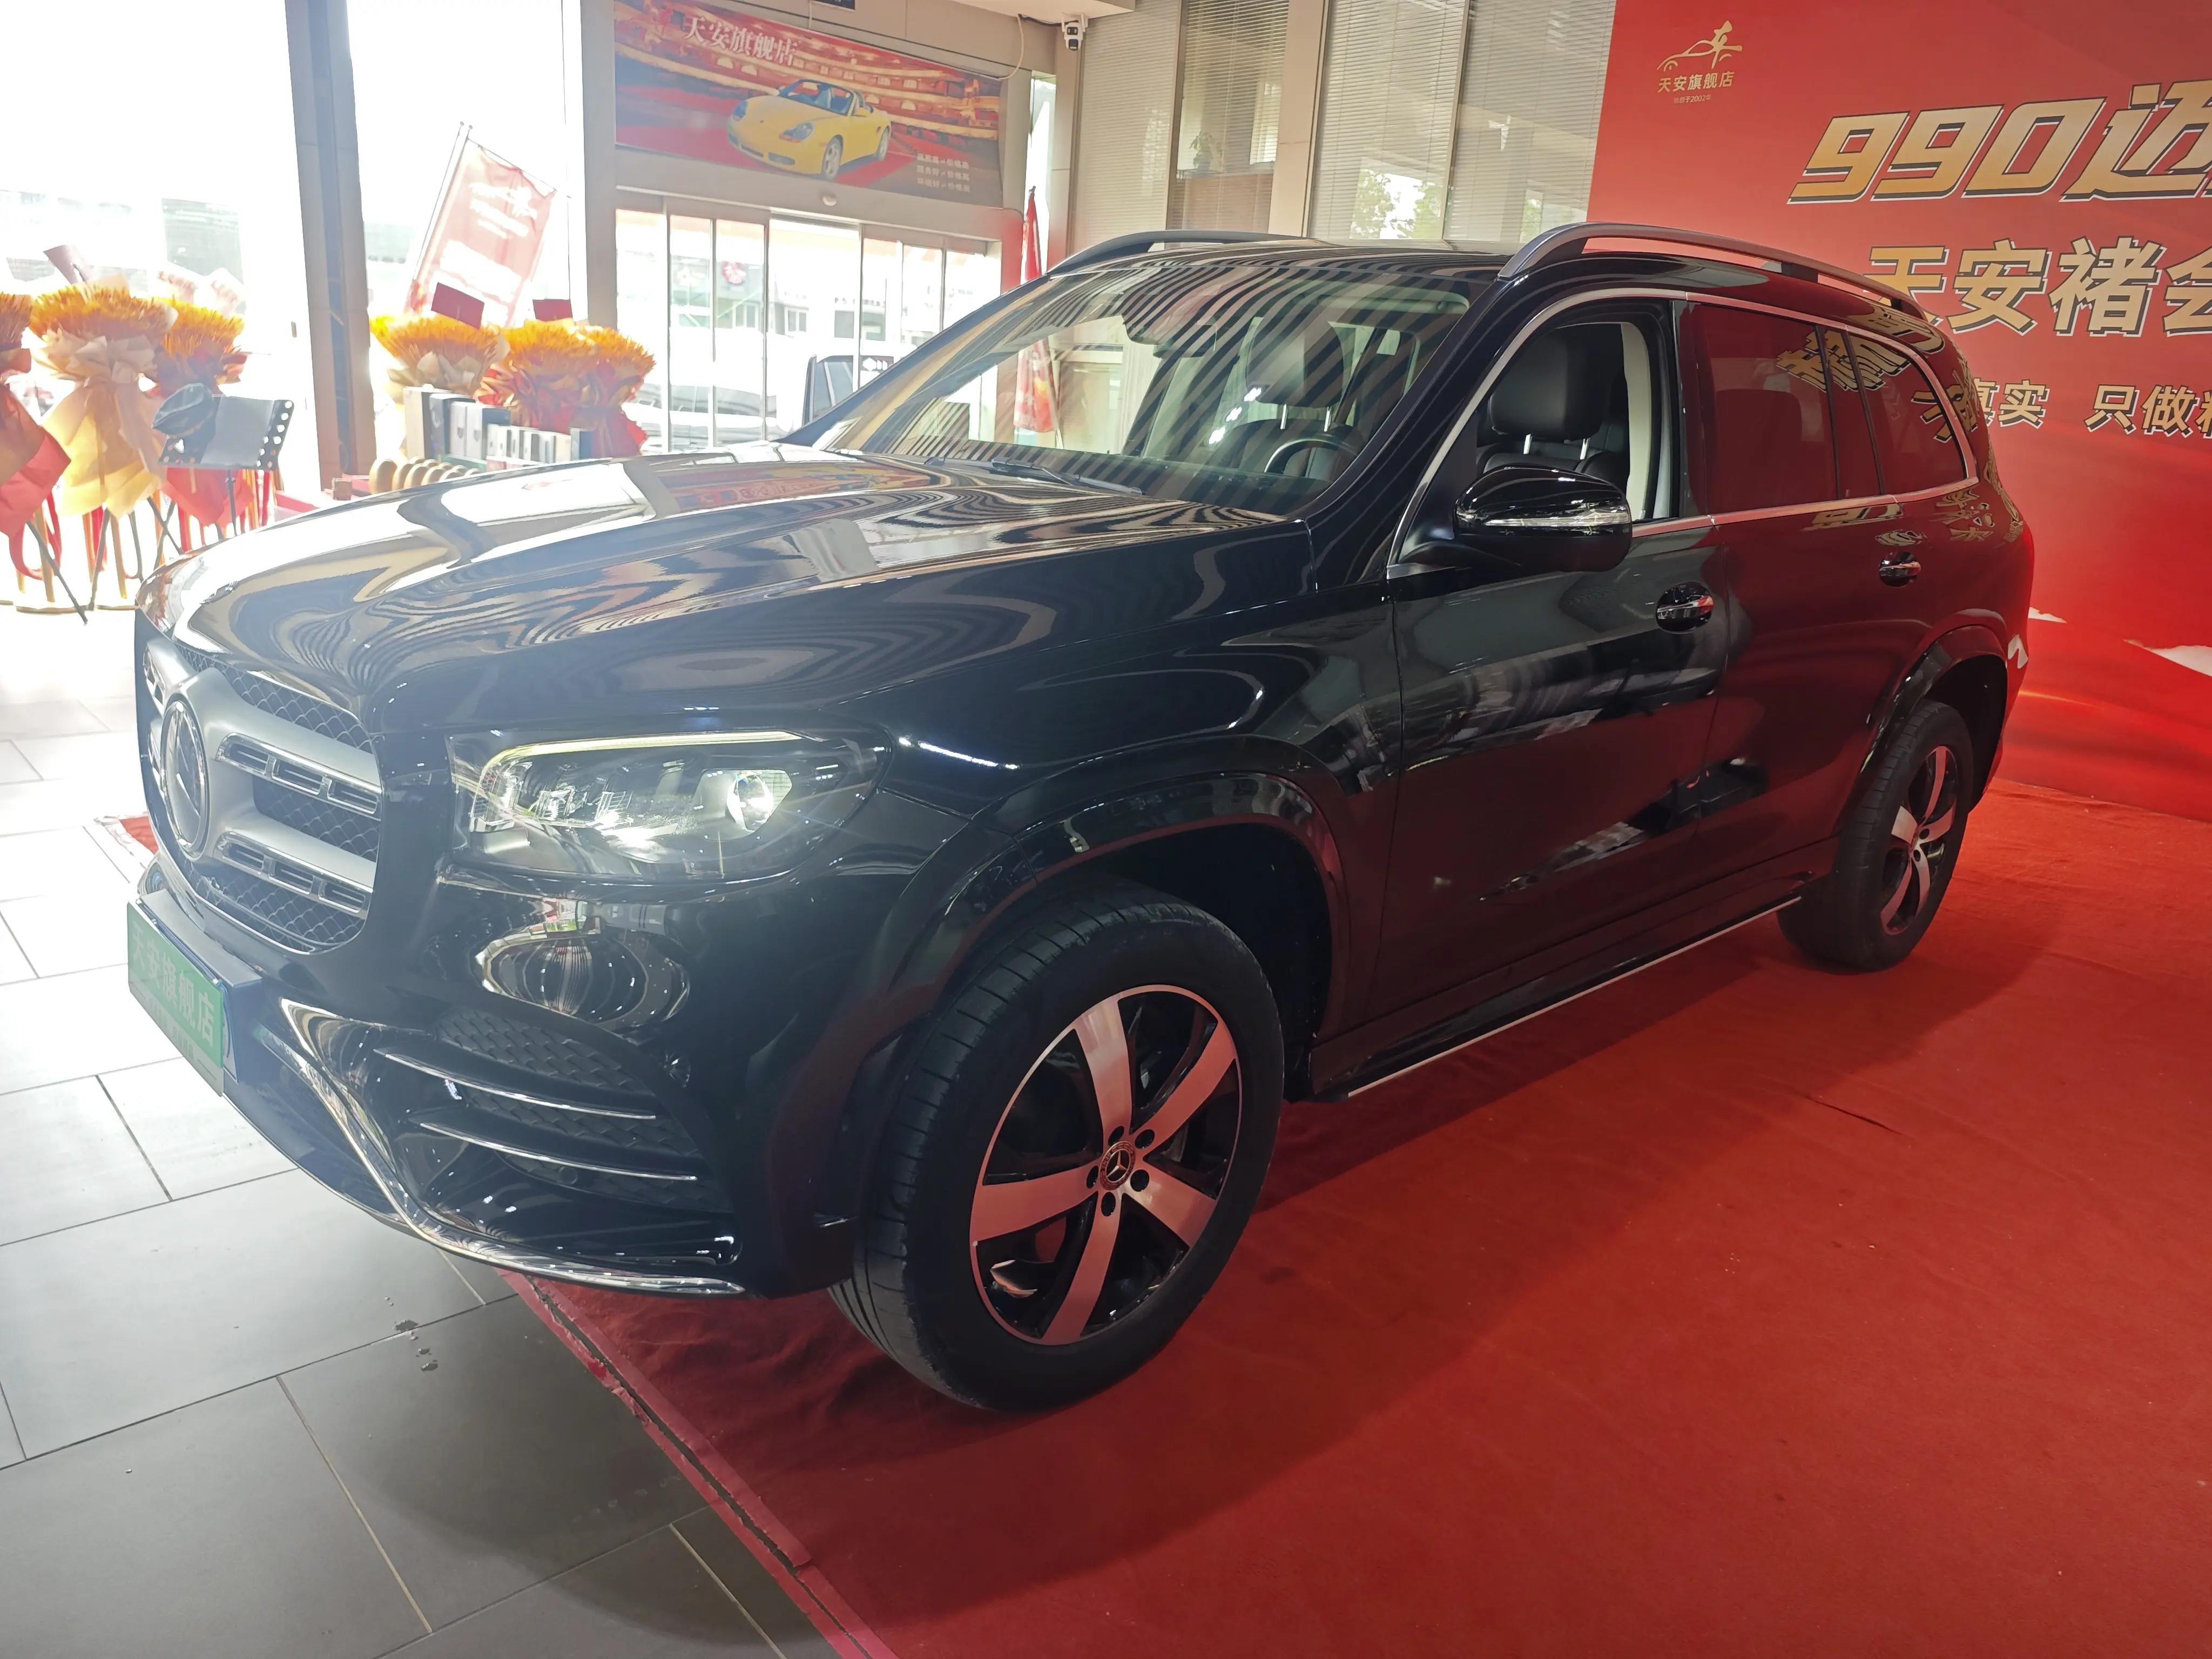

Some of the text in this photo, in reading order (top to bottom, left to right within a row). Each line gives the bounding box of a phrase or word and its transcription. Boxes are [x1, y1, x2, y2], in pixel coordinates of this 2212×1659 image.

[683, 16, 798, 66] 天安旗舰店
[1657, 71, 1735, 93] 天安旗舰店
[1673, 94, 1712, 104] 始创于2002年
[2083, 382, 2212, 439] 只做
[131, 918, 214, 1048] 天安旗舰店
